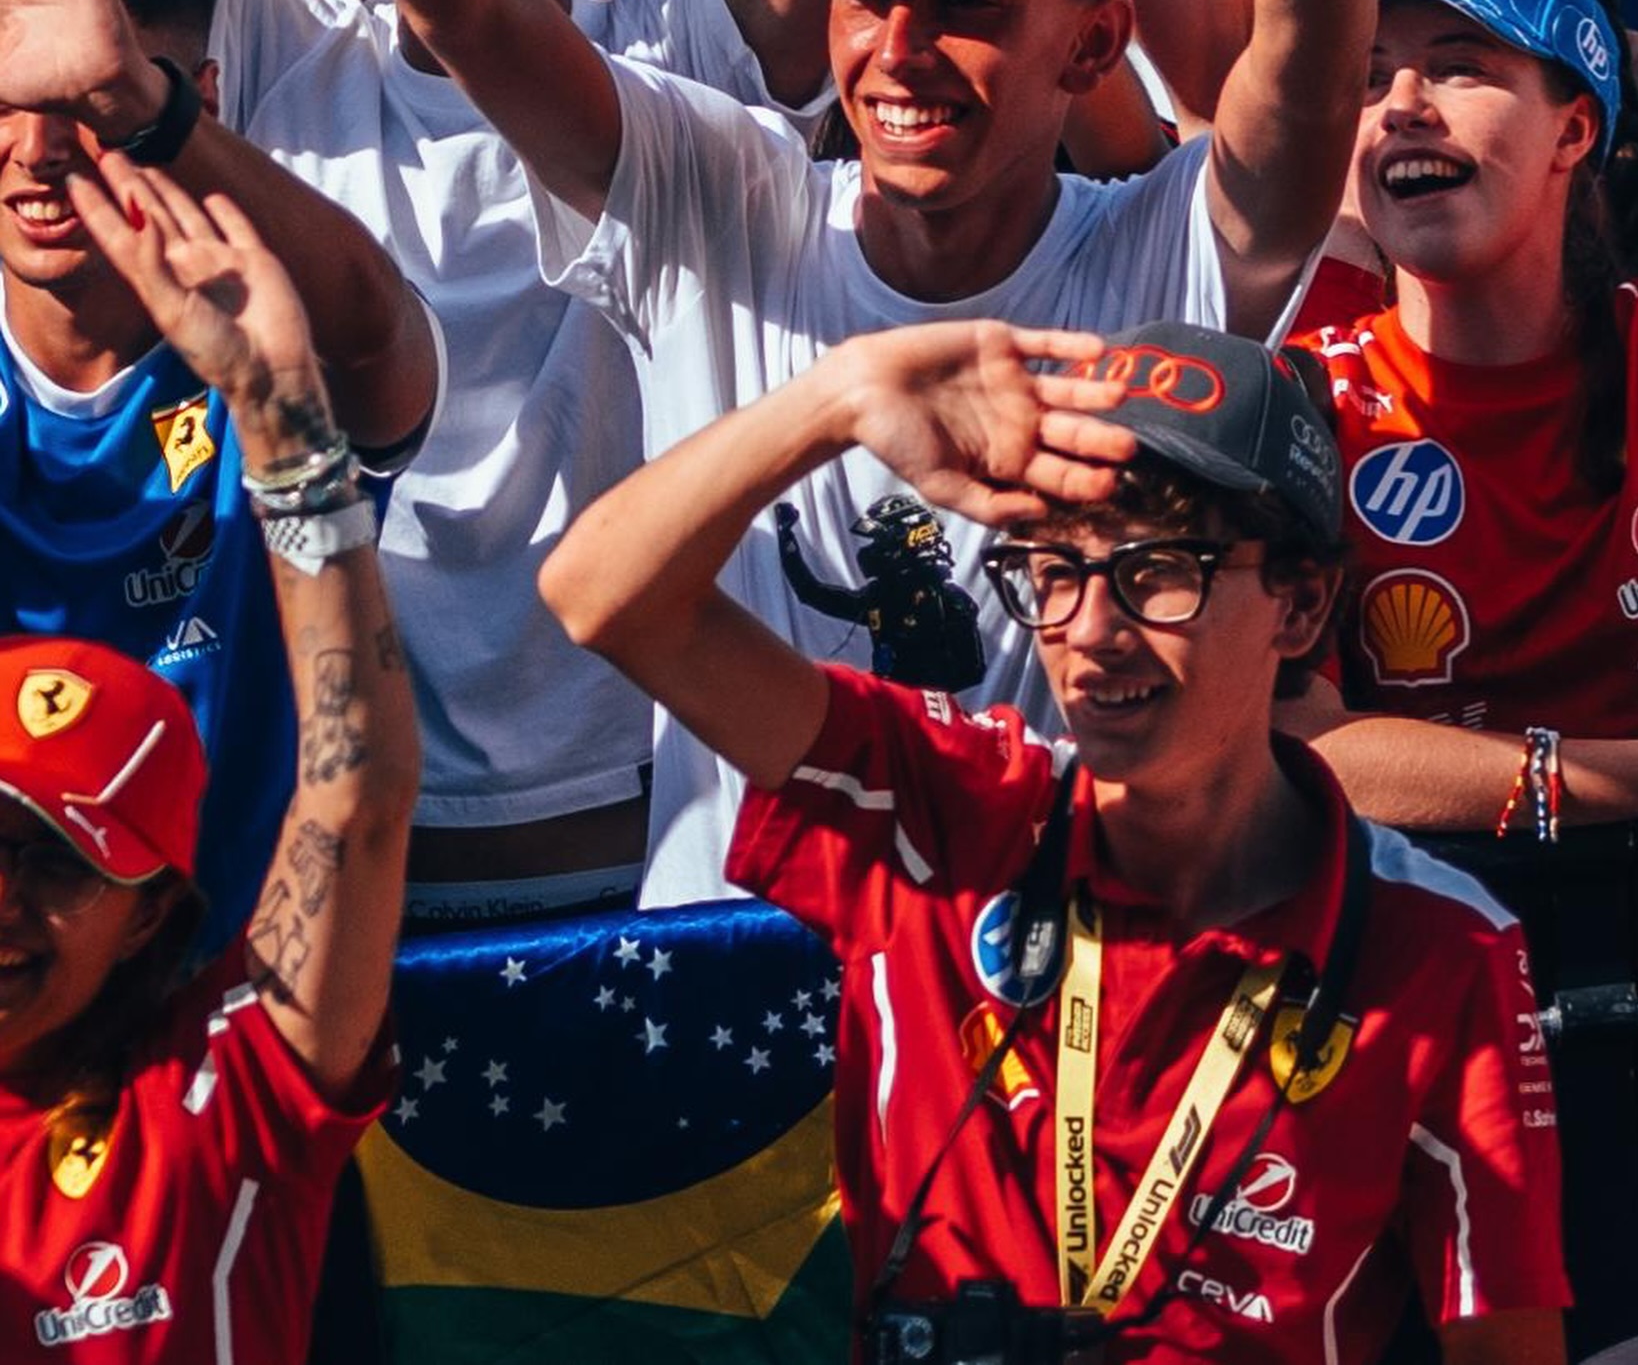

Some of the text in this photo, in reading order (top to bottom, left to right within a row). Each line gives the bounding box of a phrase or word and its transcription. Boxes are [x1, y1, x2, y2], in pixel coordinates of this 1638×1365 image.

[1580, 21, 1608, 75] hp
[1365, 445, 1453, 542] hp
[1064, 1116, 1089, 1253] Unlocked
[1101, 1178, 1175, 1303] Unlocked
